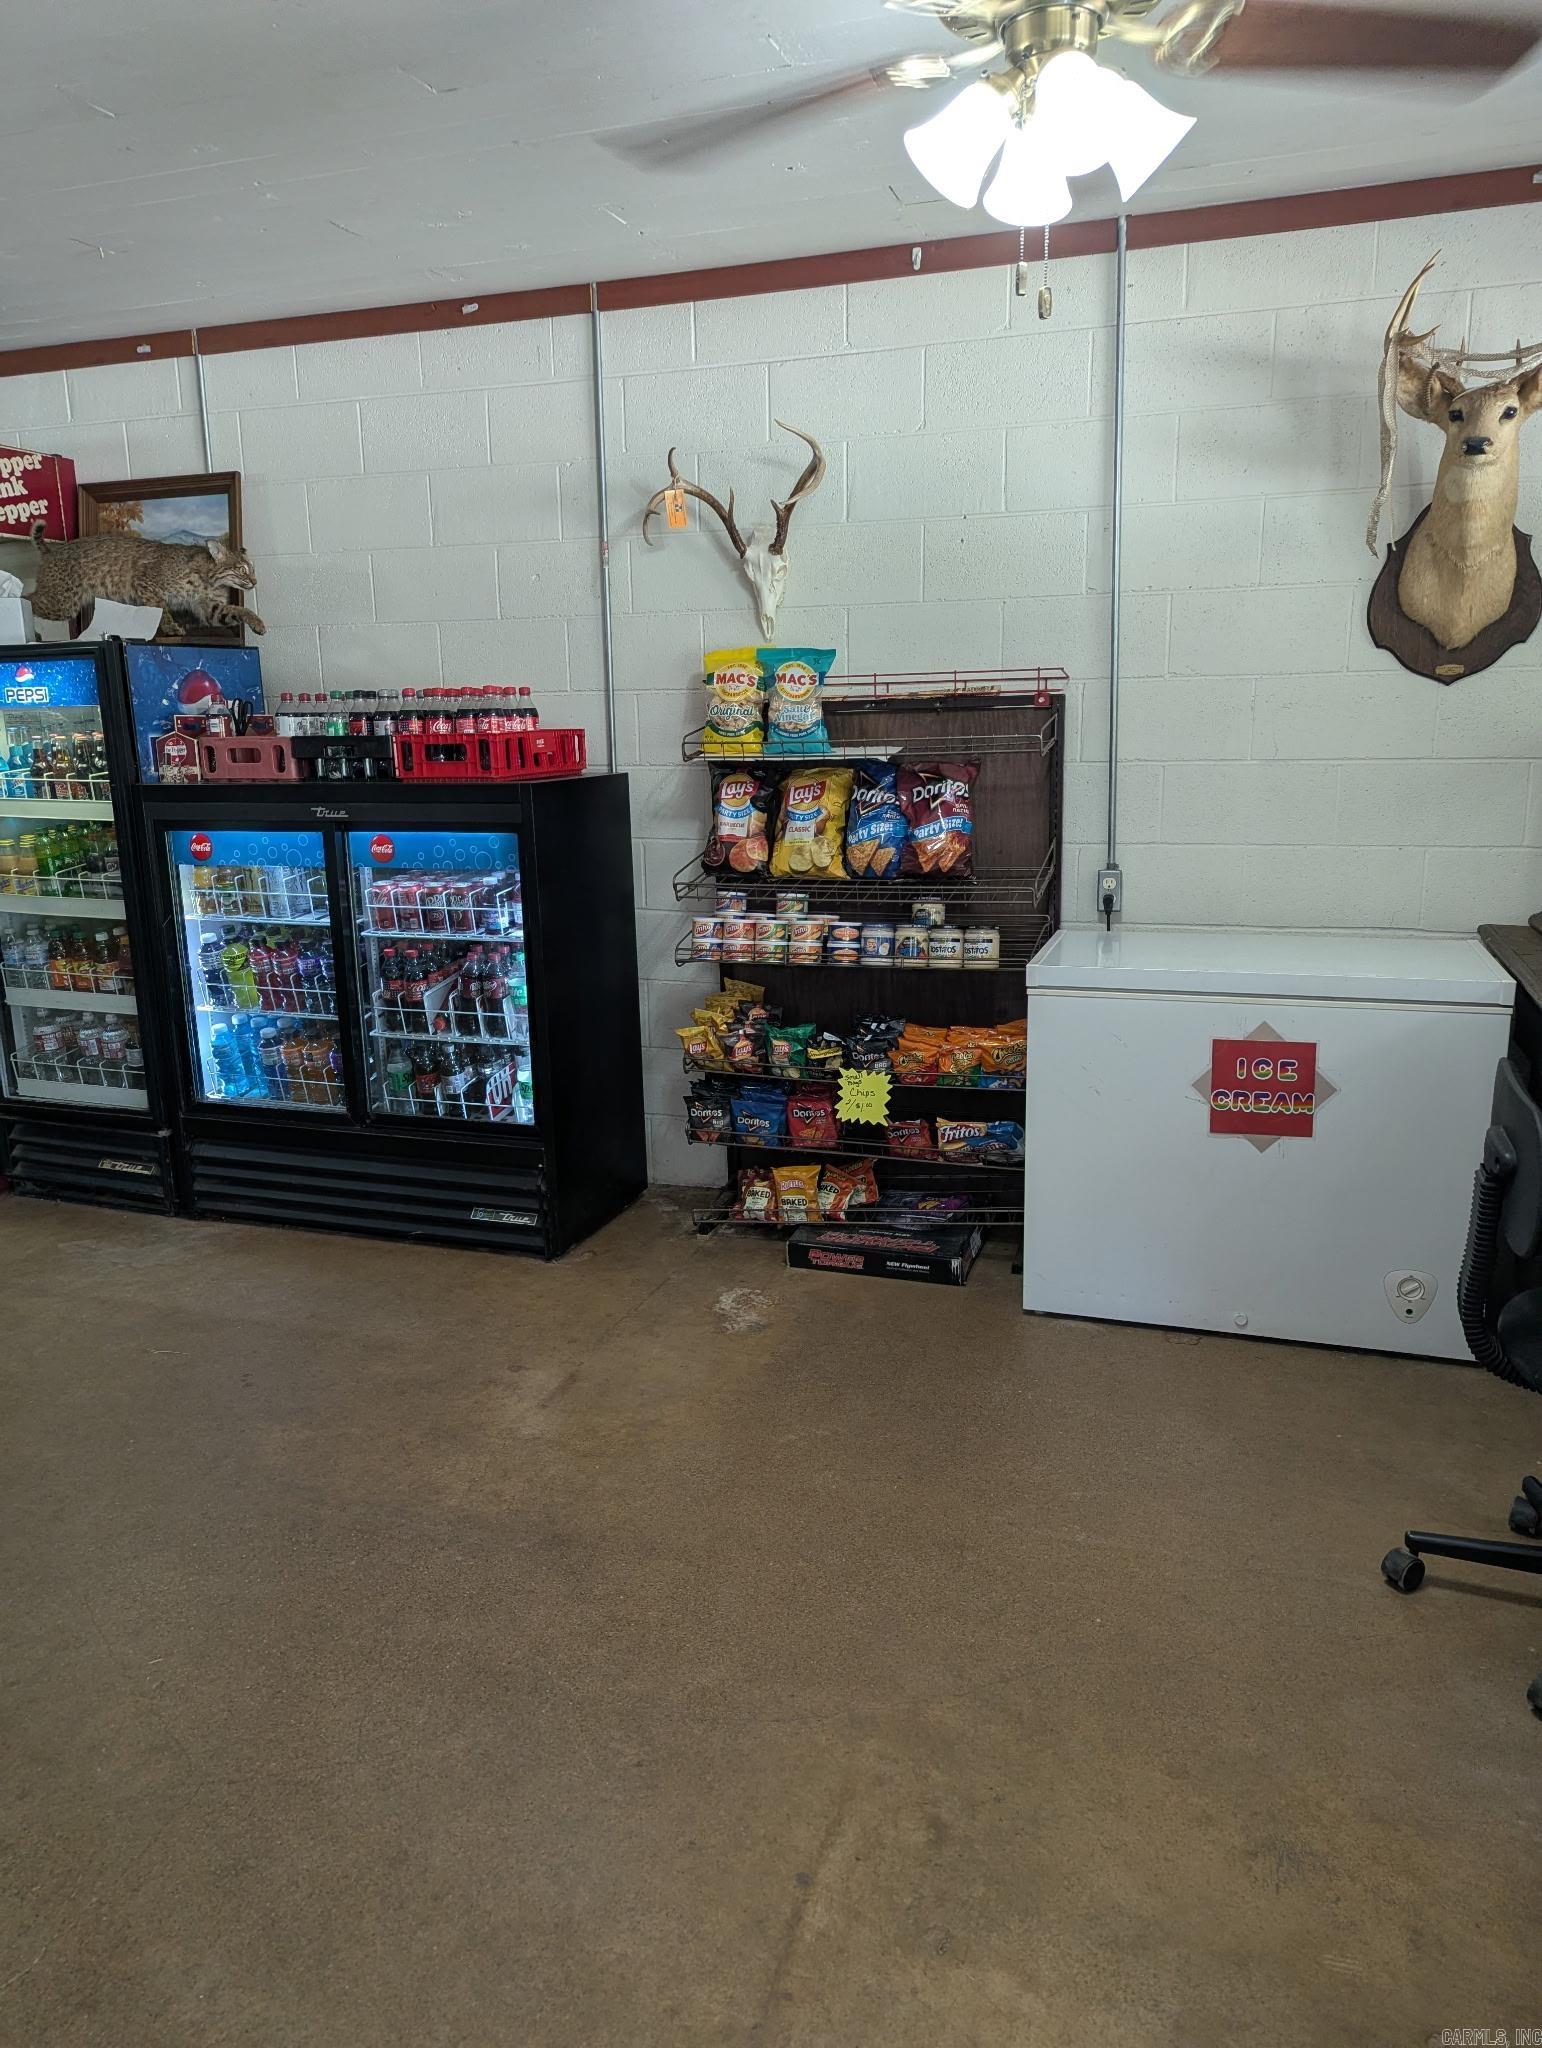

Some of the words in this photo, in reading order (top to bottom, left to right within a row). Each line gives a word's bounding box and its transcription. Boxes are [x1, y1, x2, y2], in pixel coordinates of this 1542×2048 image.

[715, 673, 757, 687] MAC'S
[776, 673, 817, 686] MAC'S
[5, 687, 49, 703] PEPSI
[710, 704, 754, 720] Original
[721, 781, 754, 800] Lay's
[788, 784, 822, 805] Lay's
[311, 806, 349, 818] True
[719, 806, 736, 817] PARTY
[688, 1042, 705, 1054] Lay's
[735, 1045, 752, 1056] Lay's
[852, 1051, 885, 1061] Doritos
[1236, 1057, 1299, 1082] ICE
[845, 1072, 863, 1080] Small
[849, 1087, 876, 1098] Chips
[1210, 1088, 1316, 1115] CREAM
[690, 1108, 722, 1117] Doritos
[793, 1109, 826, 1118] Doritos
[737, 1116, 770, 1128] Doritos
[941, 1125, 980, 1142] Fritos
[746, 1189, 771, 1199] BAKED
[820, 1184, 840, 1194] AKED
[781, 1197, 808, 1207] BAKED
[901, 1261, 930, 1270] Flywheel
